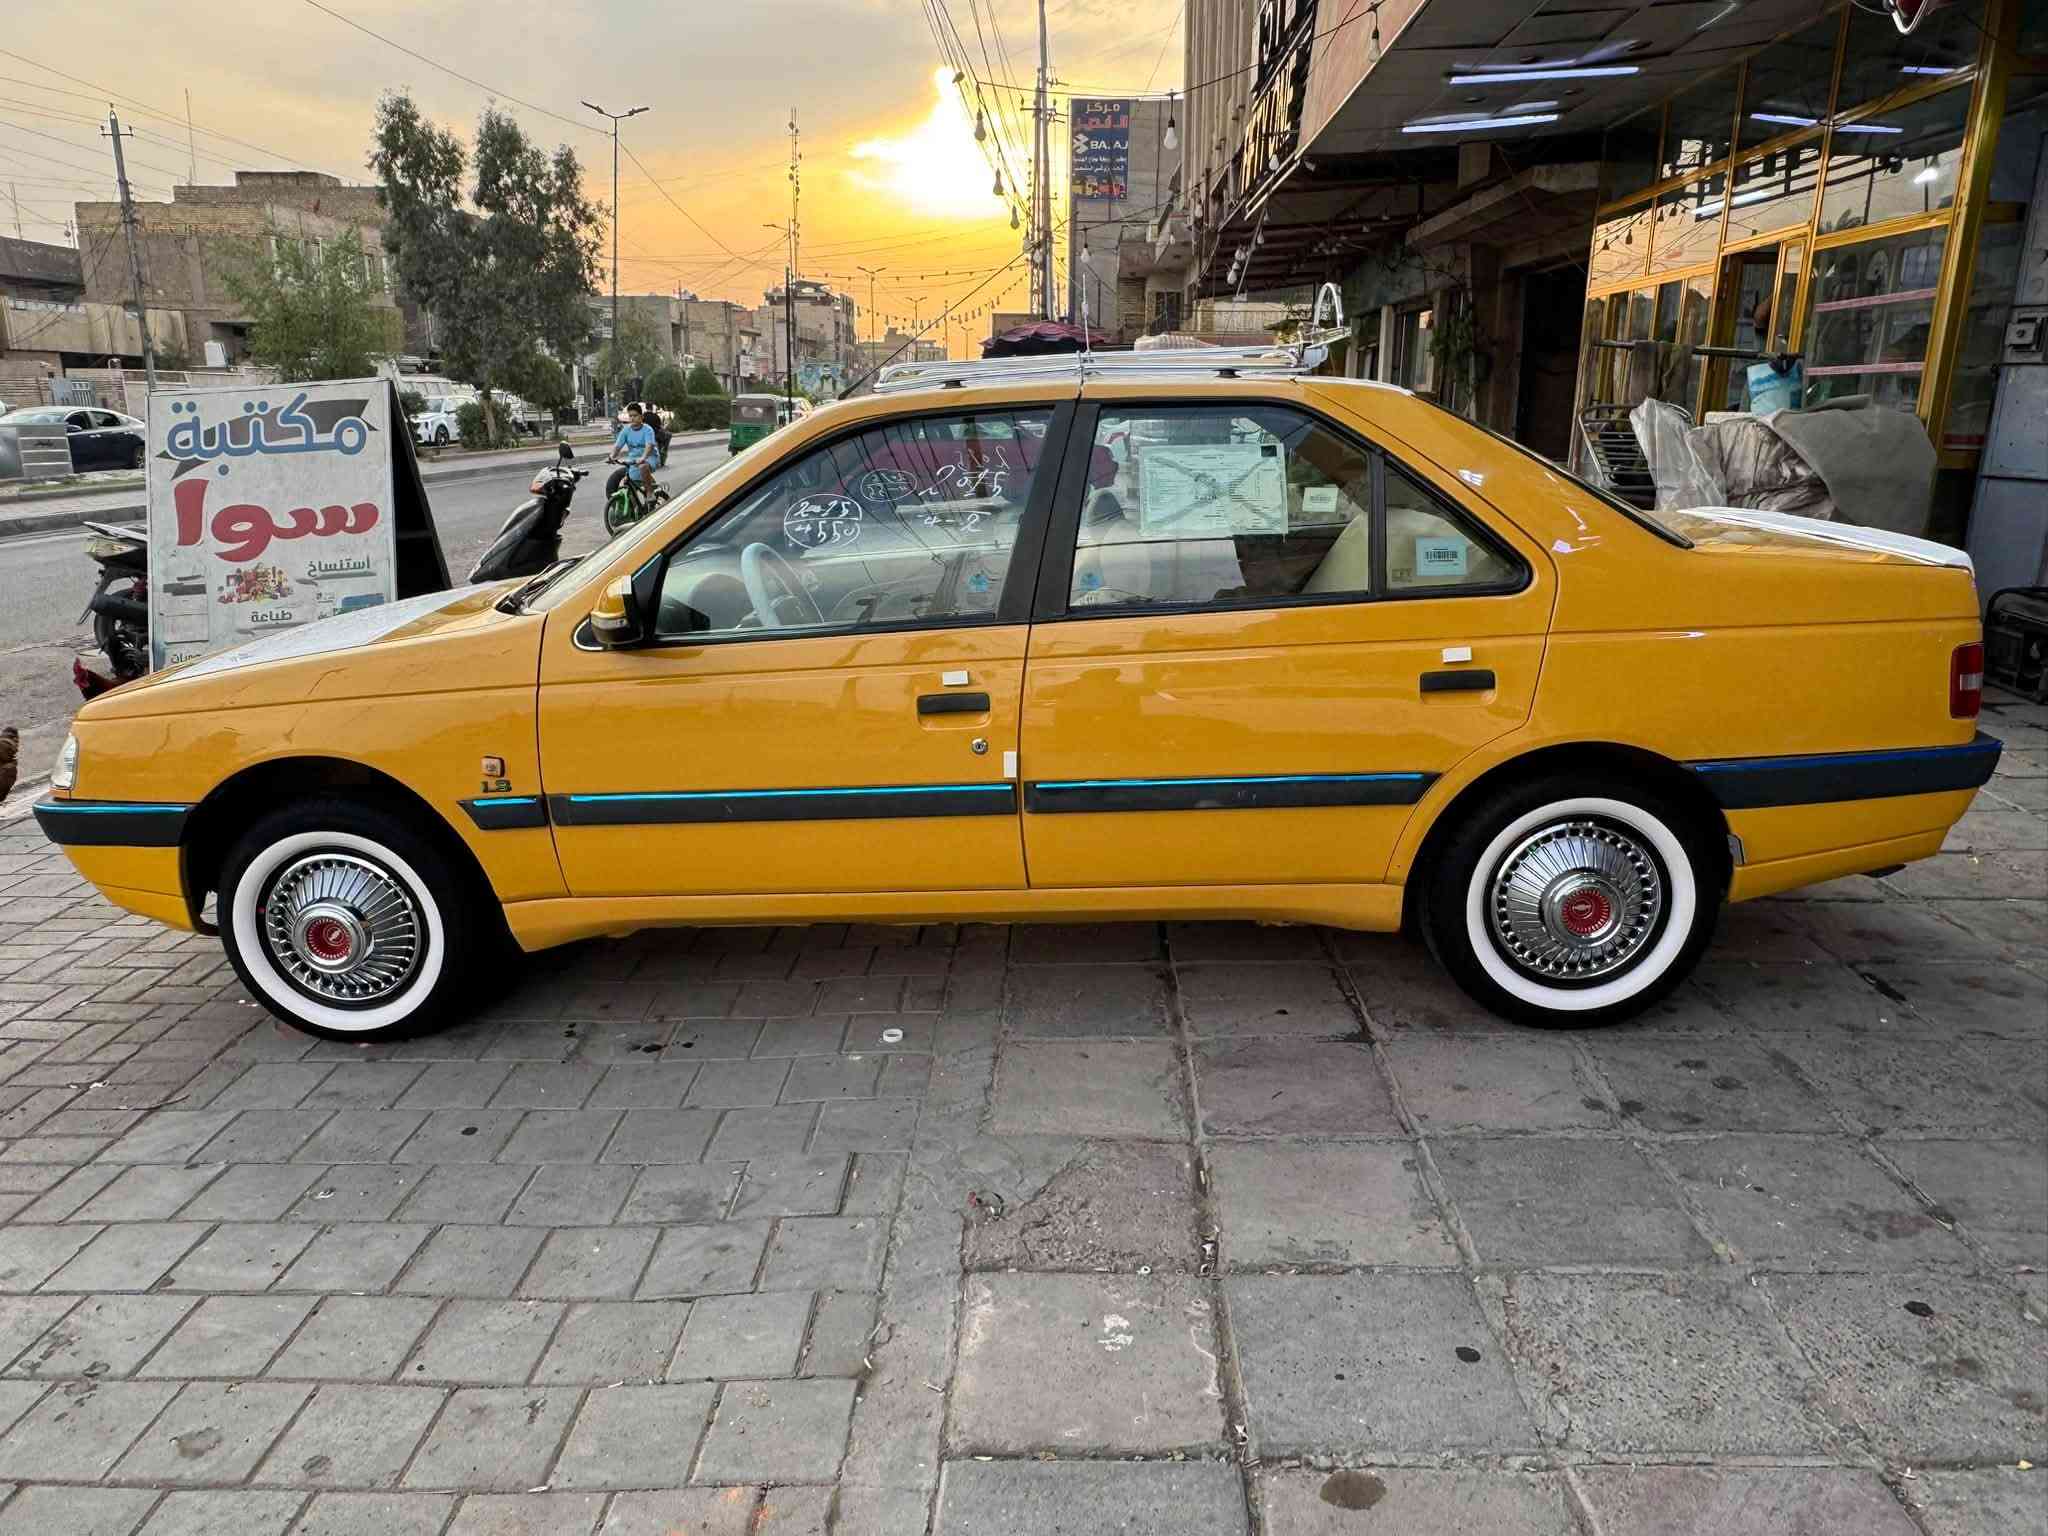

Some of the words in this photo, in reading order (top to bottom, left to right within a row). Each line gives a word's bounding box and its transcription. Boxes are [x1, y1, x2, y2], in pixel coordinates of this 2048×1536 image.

[1090, 140, 1129, 150] BAAJ
[167, 392, 368, 476] مكتبة
[174, 478, 380, 563] سوا
[251, 610, 293, 625] طباعة
